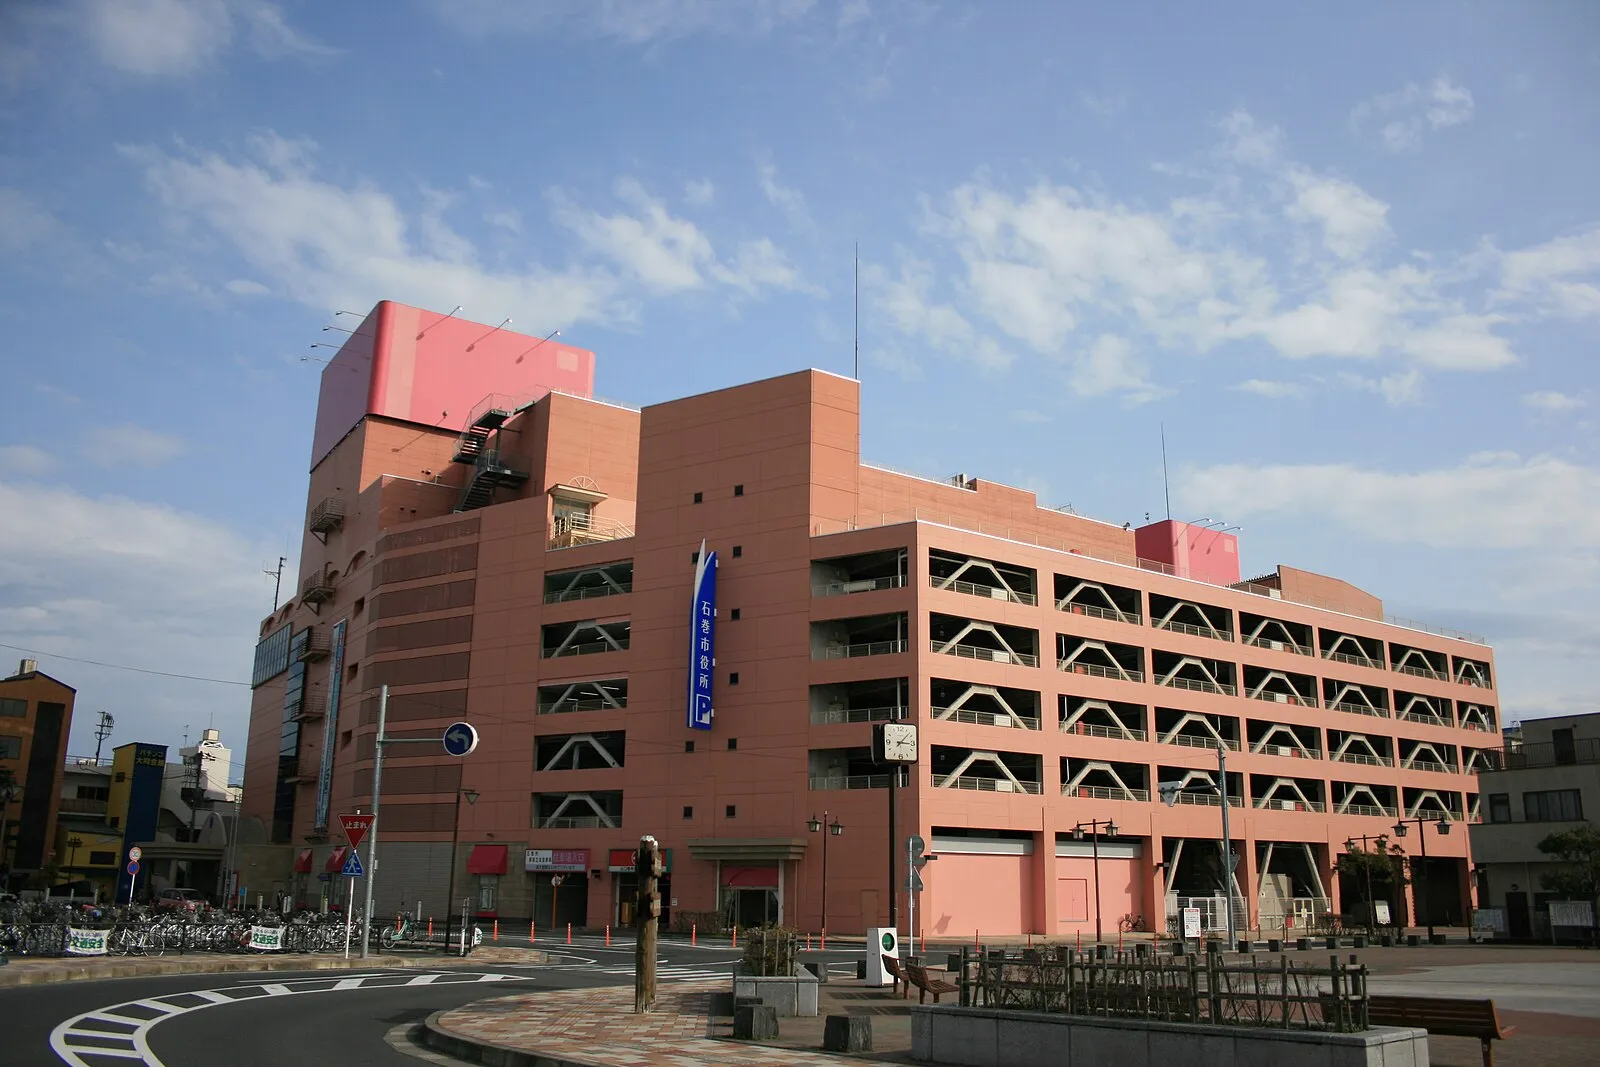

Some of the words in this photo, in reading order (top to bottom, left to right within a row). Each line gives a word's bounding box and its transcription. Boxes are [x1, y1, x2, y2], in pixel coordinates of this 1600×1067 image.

[699, 600, 711, 689] 石巻市役所
[696, 694, 711, 724] P
[346, 821, 366, 829] 止まれ
[70, 936, 104, 949] 交通安全
[252, 932, 278, 944] 交通安全
